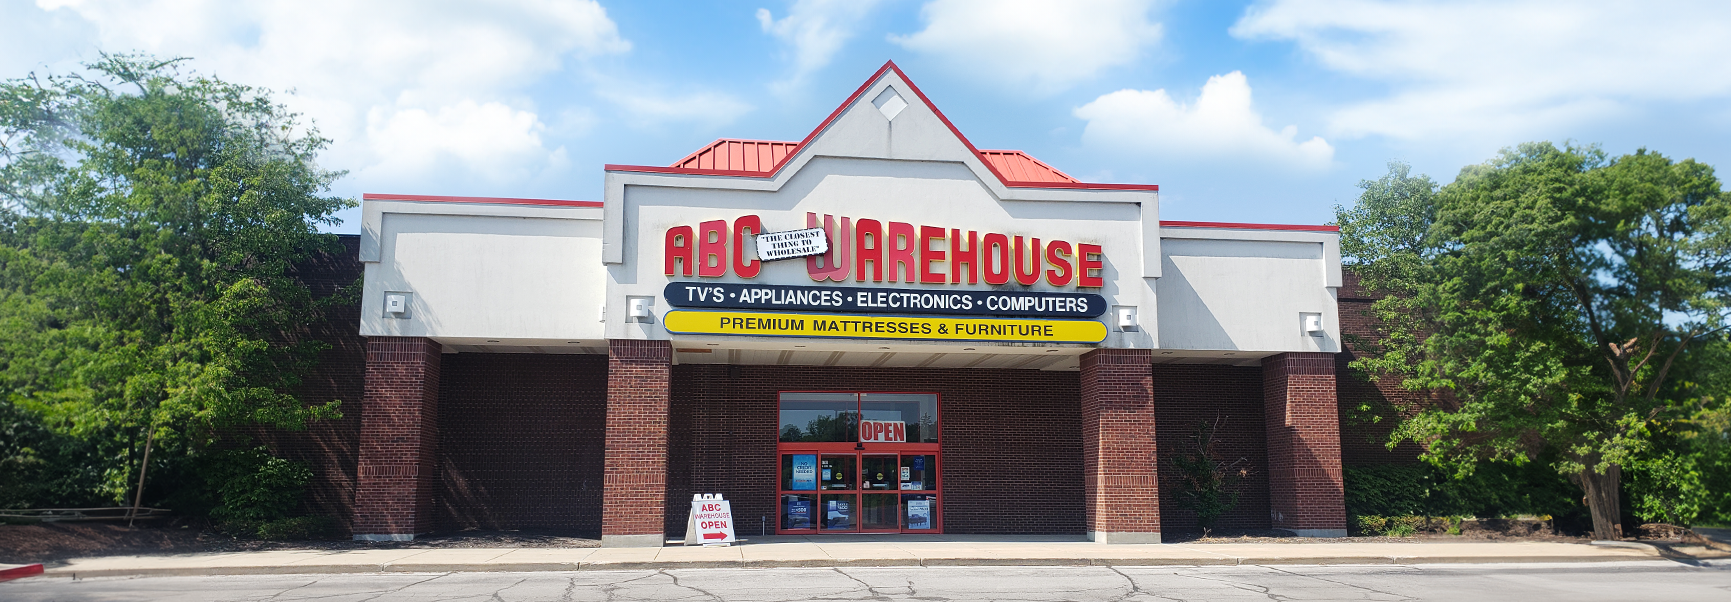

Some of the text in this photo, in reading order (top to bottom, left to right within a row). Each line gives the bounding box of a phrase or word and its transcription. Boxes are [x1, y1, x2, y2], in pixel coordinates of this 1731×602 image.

[784, 231, 820, 240] CLOSEST
[664, 212, 1104, 287] ABC WAREHOUSE
[771, 240, 799, 250] THING
[766, 245, 820, 257] WHOLESALE"
[739, 288, 843, 307] APPLIANCES
[857, 291, 973, 310] ELECTRONICS
[986, 295, 1088, 313] COMPUTERS
[720, 316, 1054, 337] PREMIUM MATTRESSES & FURNITURE
[861, 421, 905, 441] OPEN
[701, 503, 722, 512] ABC
[694, 512, 730, 520] WAREHOUSE
[700, 520, 728, 530] OPEN
